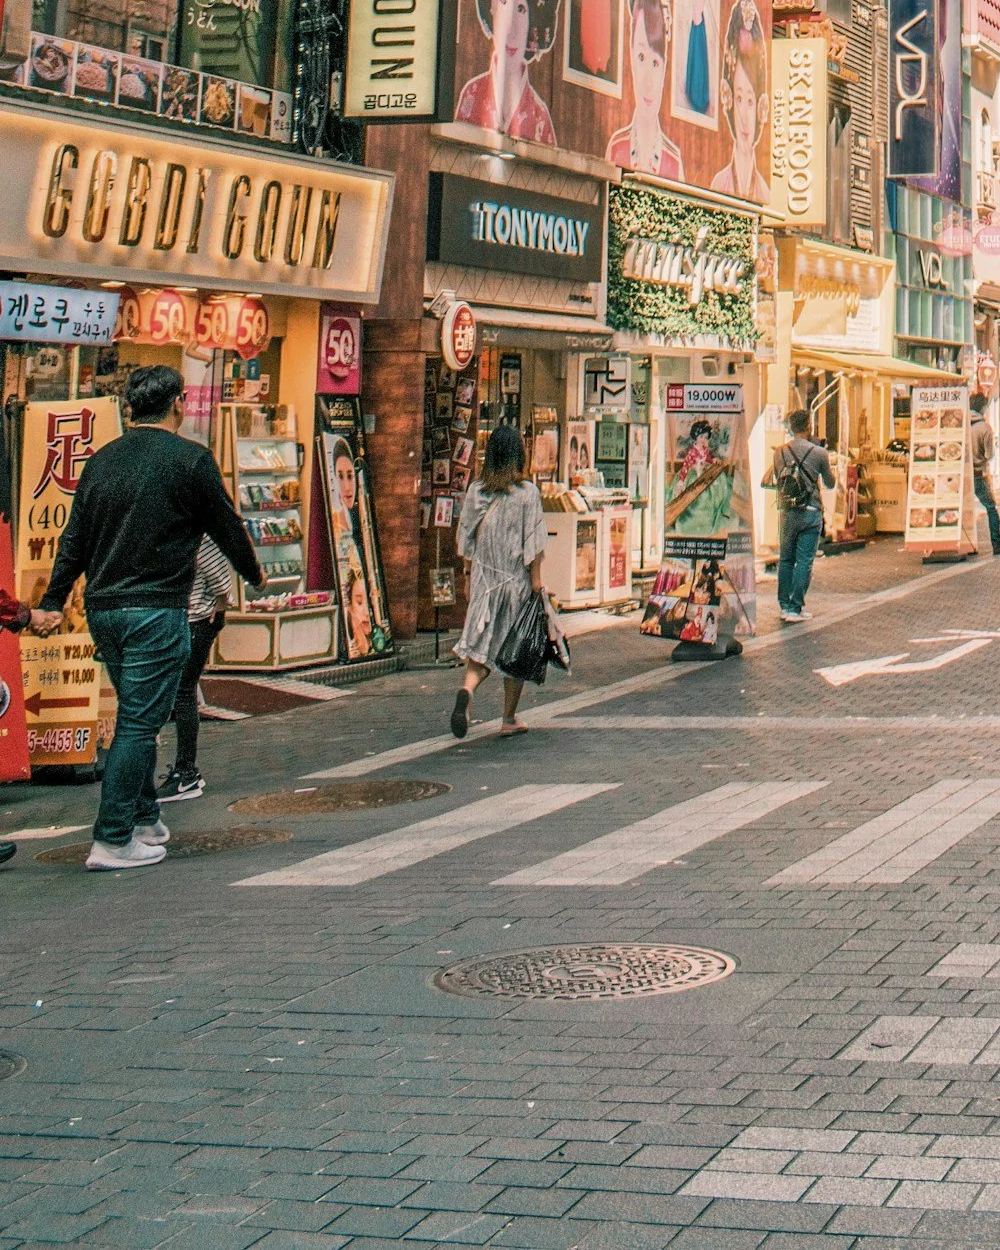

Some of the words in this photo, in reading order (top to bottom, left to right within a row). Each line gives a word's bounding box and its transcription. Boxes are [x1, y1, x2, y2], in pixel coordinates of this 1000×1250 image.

[894, 9, 928, 141] VDL
[363, 94, 418, 110] 곱디고운
[788, 49, 815, 216] SKINFOOD
[42, 144, 212, 254] GOBDI
[222, 173, 343, 270] GOUN
[8, 293, 70, 333] 겐로쿠
[151, 301, 186, 341] 50
[196, 304, 228, 344] 50
[236, 308, 268, 347] 50
[327, 329, 353, 366] 50
[33, 407, 96, 499] 足
[75, 728, 90, 752] 3F
